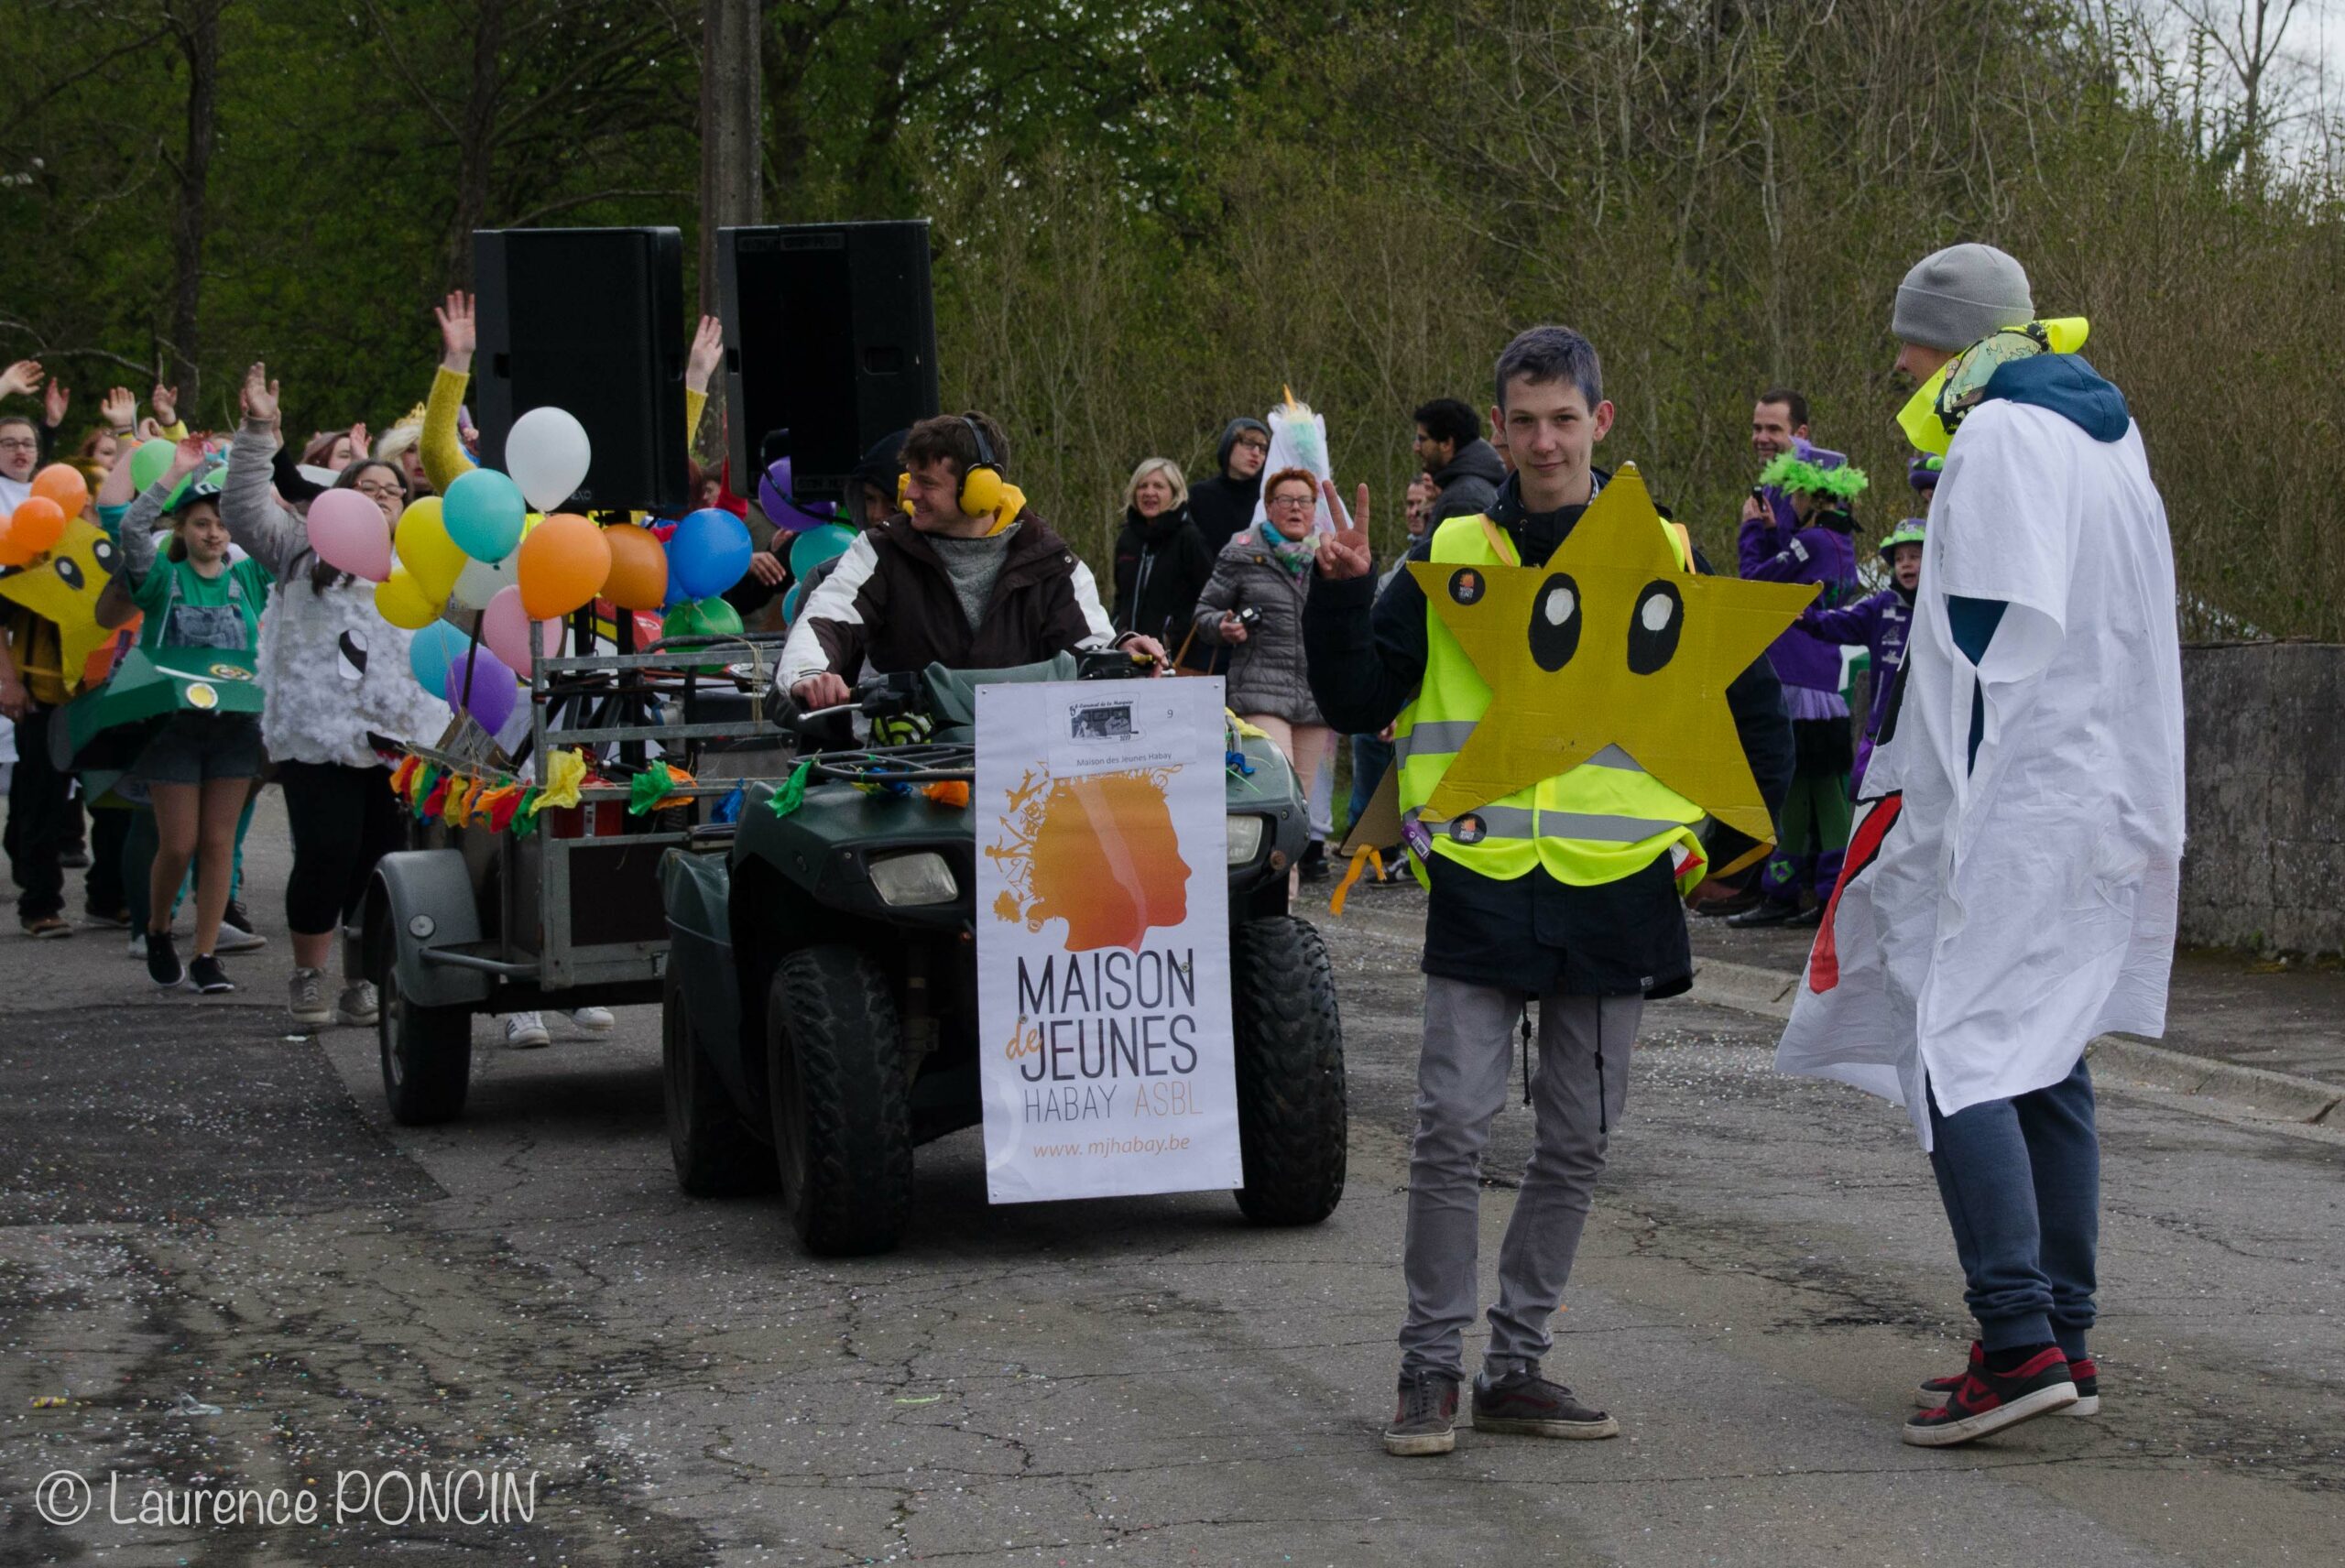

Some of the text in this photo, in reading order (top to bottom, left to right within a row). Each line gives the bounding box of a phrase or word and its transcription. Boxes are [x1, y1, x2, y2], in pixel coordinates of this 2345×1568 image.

[1167, 709, 1173, 719] 9
[1076, 757, 1105, 767] Maison
[1120, 754, 1147, 763] Jeunes
[1148, 752, 1172, 761] Habay
[1018, 948, 1195, 1015] MAISON
[1006, 1014, 1198, 1083] de JEUNES
[1024, 1081, 1204, 1124] HABAY ASBL
